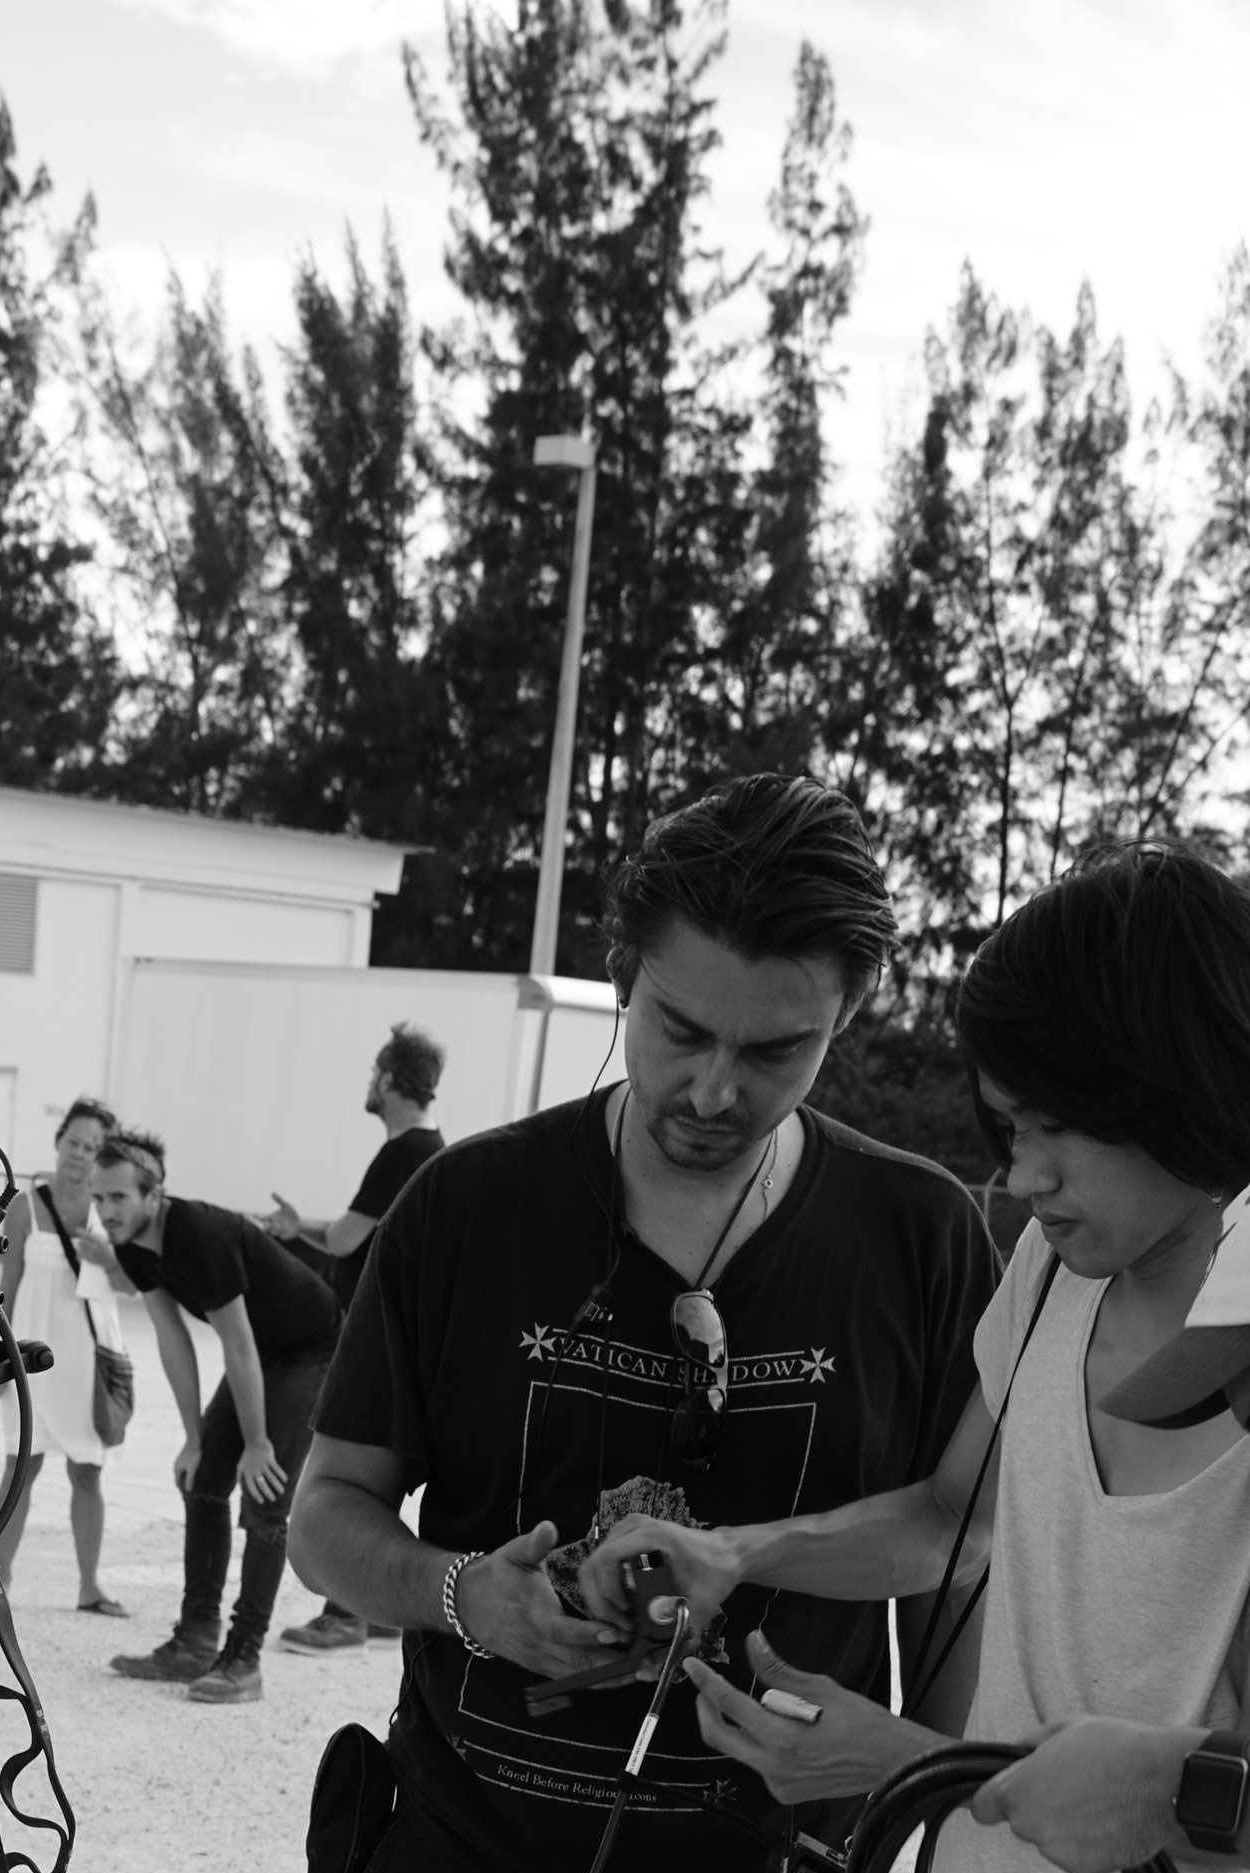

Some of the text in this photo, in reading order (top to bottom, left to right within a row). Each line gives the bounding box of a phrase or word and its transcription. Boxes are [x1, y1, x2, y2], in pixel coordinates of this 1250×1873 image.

[560, 1338, 797, 1385] VATICAN SHDOW
[498, 1764, 529, 1783] Kneel
[533, 1775, 569, 1792] Before
[573, 1782, 620, 1799] Religiou
